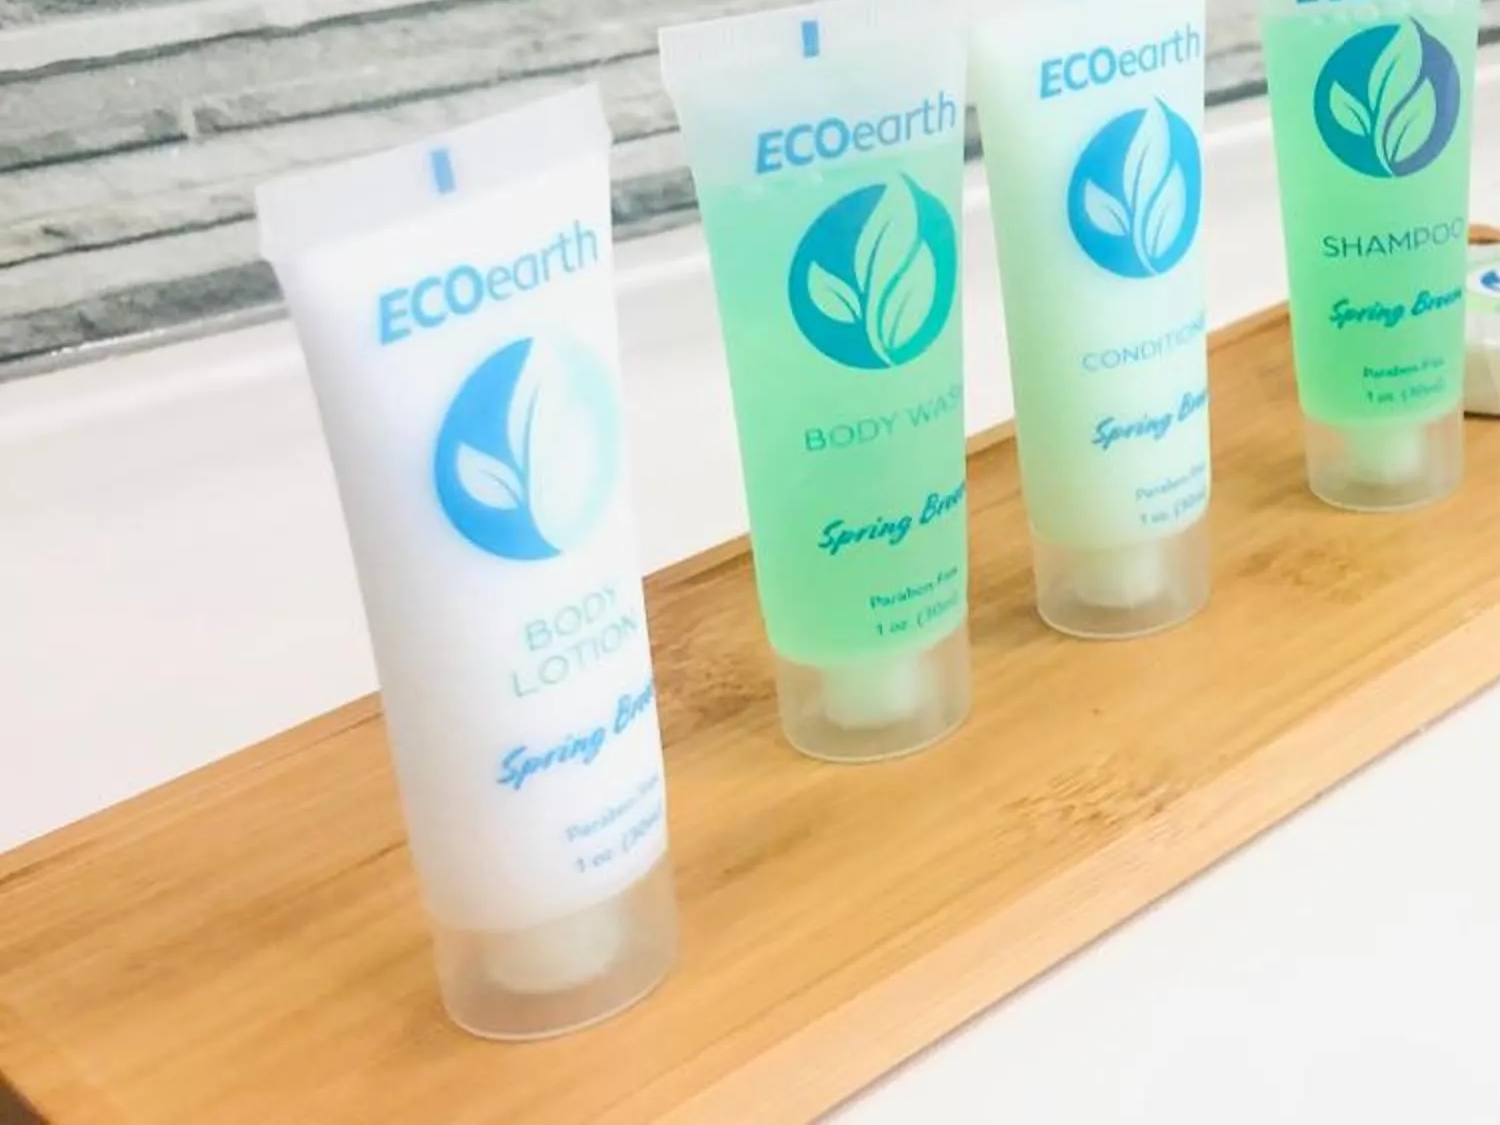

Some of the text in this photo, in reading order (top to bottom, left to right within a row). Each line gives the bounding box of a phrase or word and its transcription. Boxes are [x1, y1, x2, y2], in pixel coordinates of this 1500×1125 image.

[1039, 22, 1201, 100] ECOearth
[755, 90, 957, 175] ECOearth
[1322, 215, 1465, 259] SHAMPOO
[379, 218, 599, 346] ECOearth
[1328, 298, 1406, 330] Spring
[804, 383, 964, 452] BODY WAS
[1091, 411, 1174, 452] Spring
[817, 516, 913, 556] Spring
[524, 582, 617, 653] BODY
[497, 726, 606, 791] Spring
